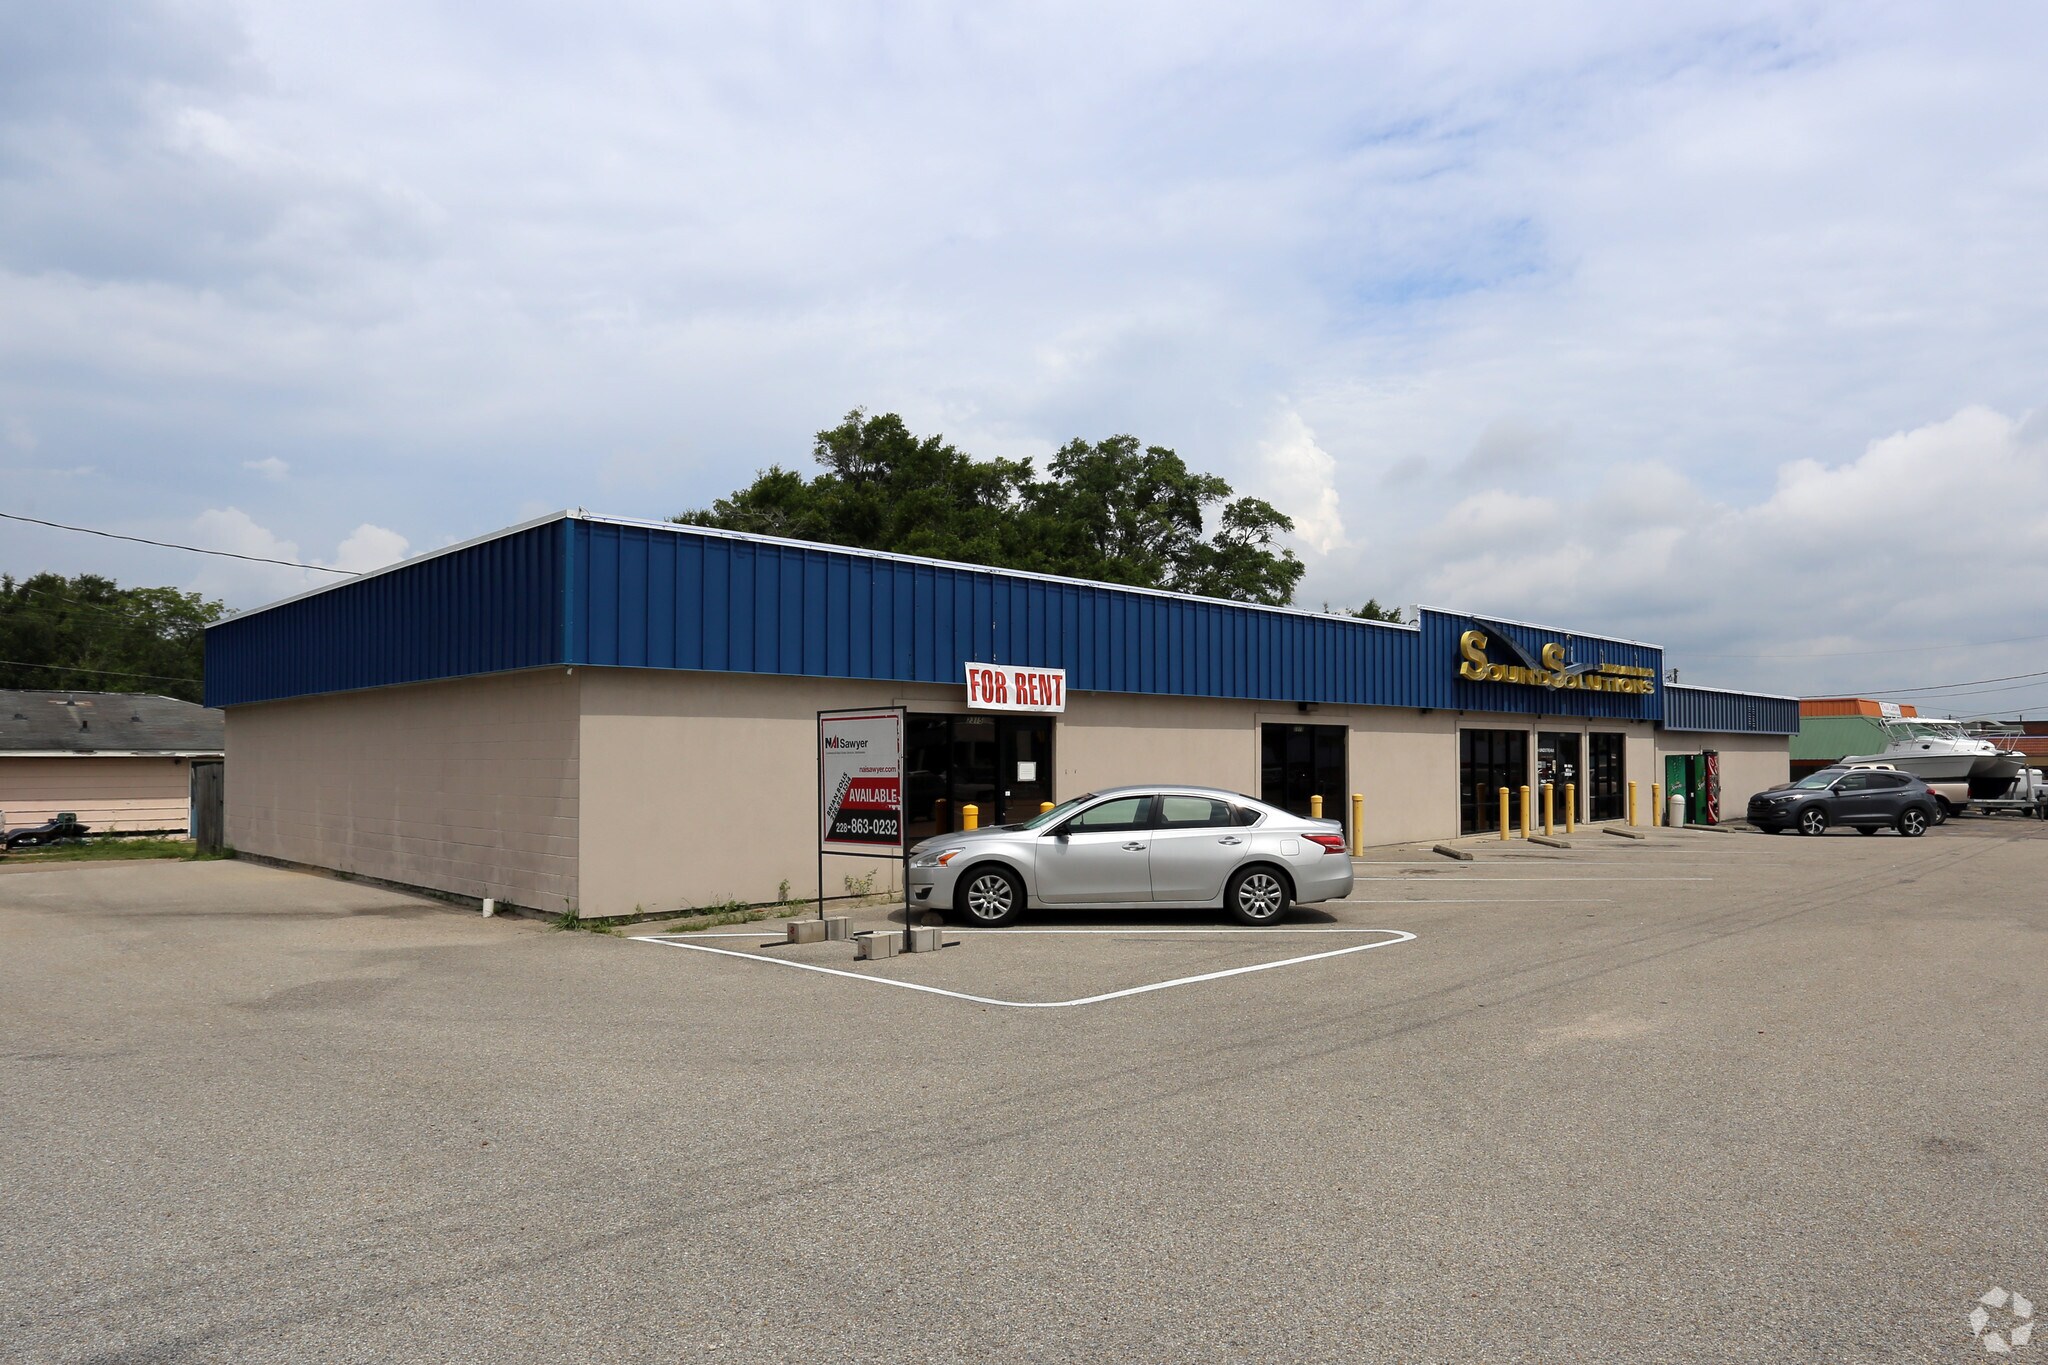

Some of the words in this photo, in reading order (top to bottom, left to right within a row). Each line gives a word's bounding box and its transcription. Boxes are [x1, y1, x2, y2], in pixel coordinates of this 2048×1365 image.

[969, 669, 1007, 704] FOR
[1014, 672, 1063, 706] RENT
[825, 734, 839, 749] NAI
[840, 738, 868, 750] Sawyer
[859, 765, 897, 774] naisawyer.com
[826, 793, 839, 817] BRIAN
[836, 771, 848, 794] BOLIS
[849, 788, 897, 803] AVAILABLE
[836, 818, 898, 835] 228-863-0232
